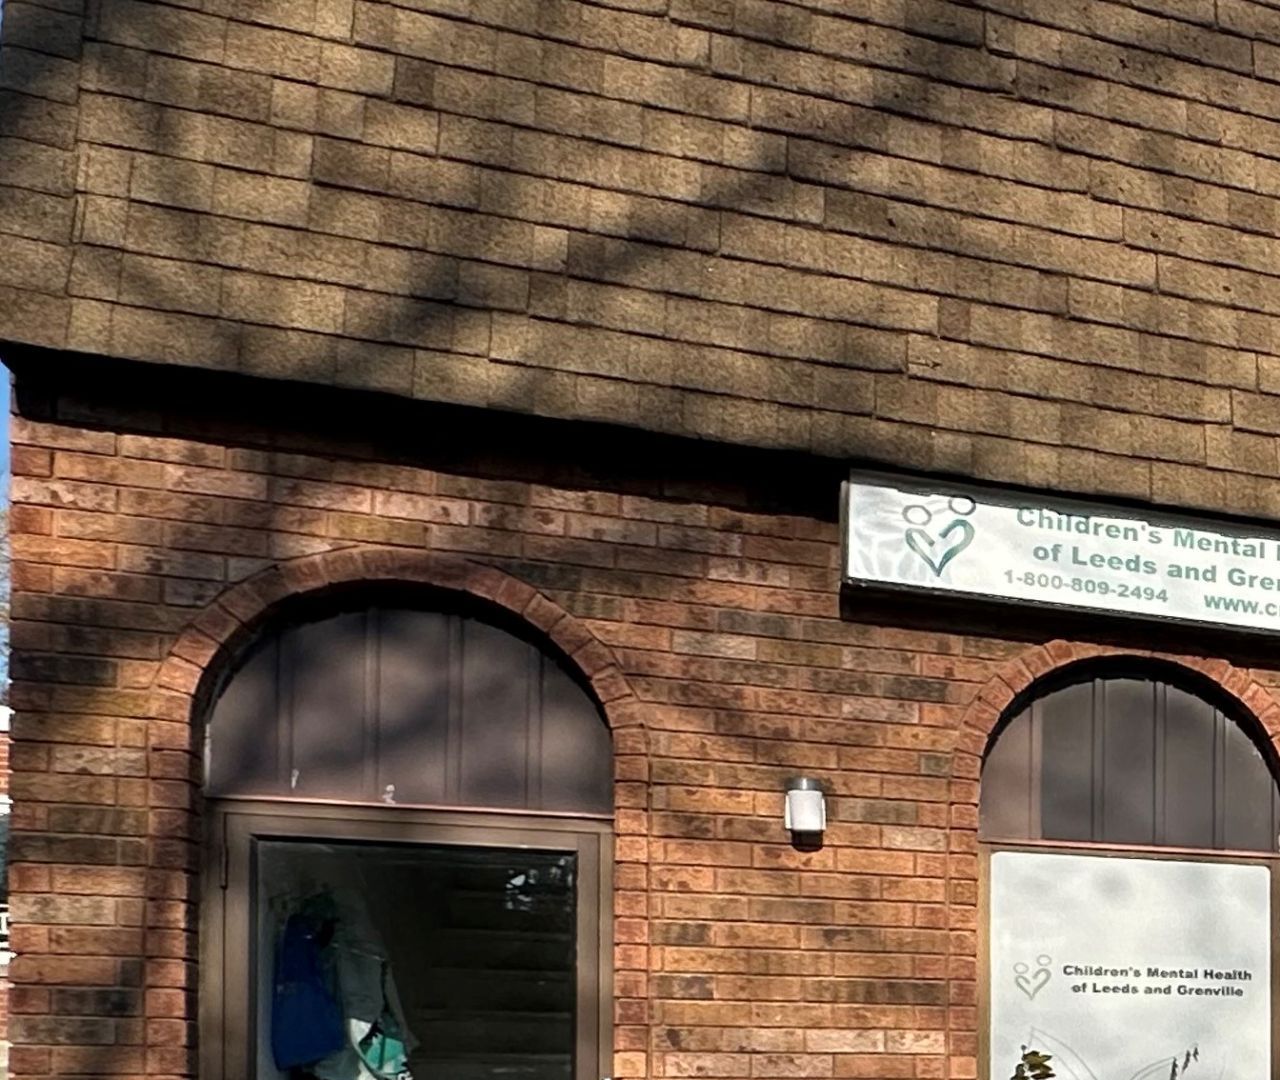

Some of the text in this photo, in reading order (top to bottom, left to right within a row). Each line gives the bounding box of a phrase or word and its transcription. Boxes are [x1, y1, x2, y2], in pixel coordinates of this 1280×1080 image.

[1016, 508, 1162, 544] Children's
[1173, 529, 1265, 559] Mental
[1033, 543, 1062, 562] of
[1072, 546, 1157, 575] Leeds
[1167, 563, 1216, 583] and
[1004, 569, 1168, 602] 1-800-809-2494
[1063, 965, 1252, 981] Children's Mental Health
[1071, 982, 1243, 997] of Leeds and Grenville
